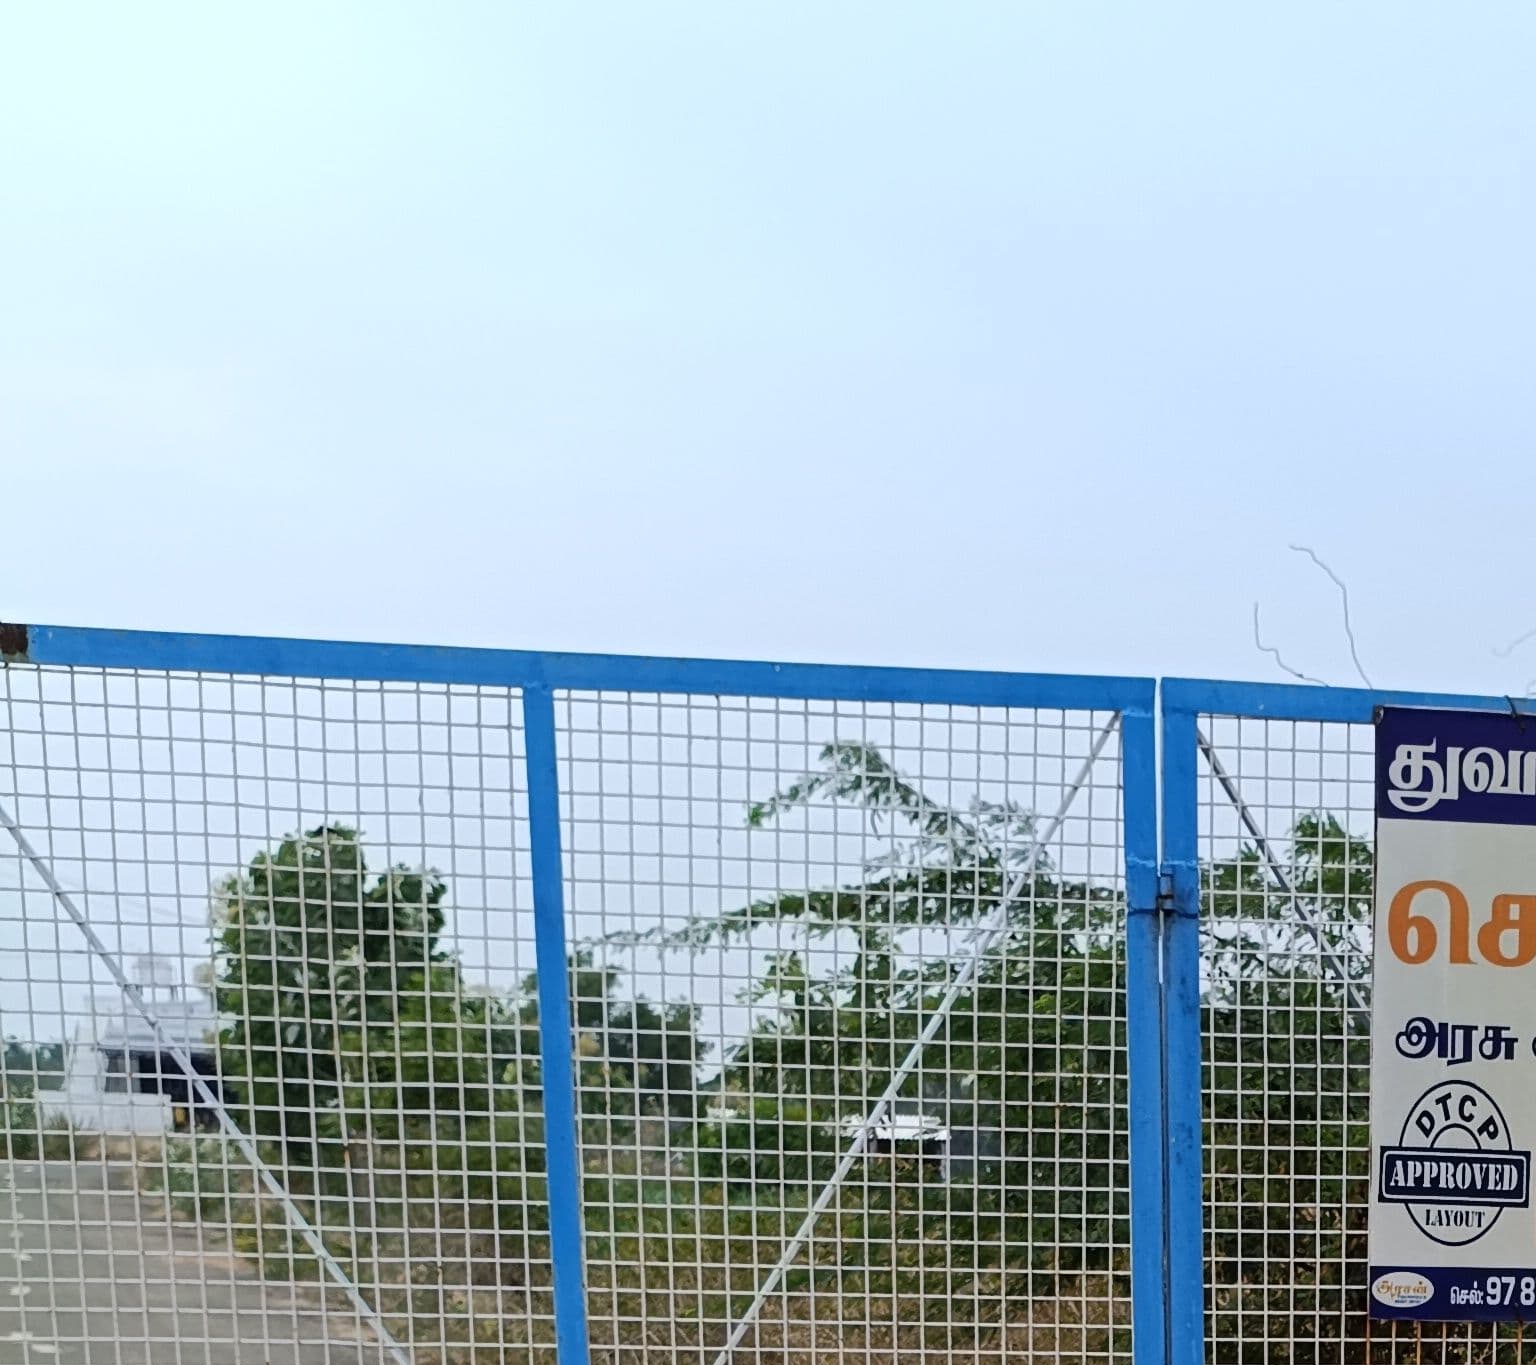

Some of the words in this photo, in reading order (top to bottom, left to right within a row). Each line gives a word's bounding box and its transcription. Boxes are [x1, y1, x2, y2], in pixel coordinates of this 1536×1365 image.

[1395, 1016, 1519, 1067] அரசு
[1416, 1091, 1500, 1141] DTCP
[1389, 1159, 1520, 1191] APPROVED
[1424, 1208, 1486, 1229] LAYOUT
[1486, 1276, 1516, 1306] 97
